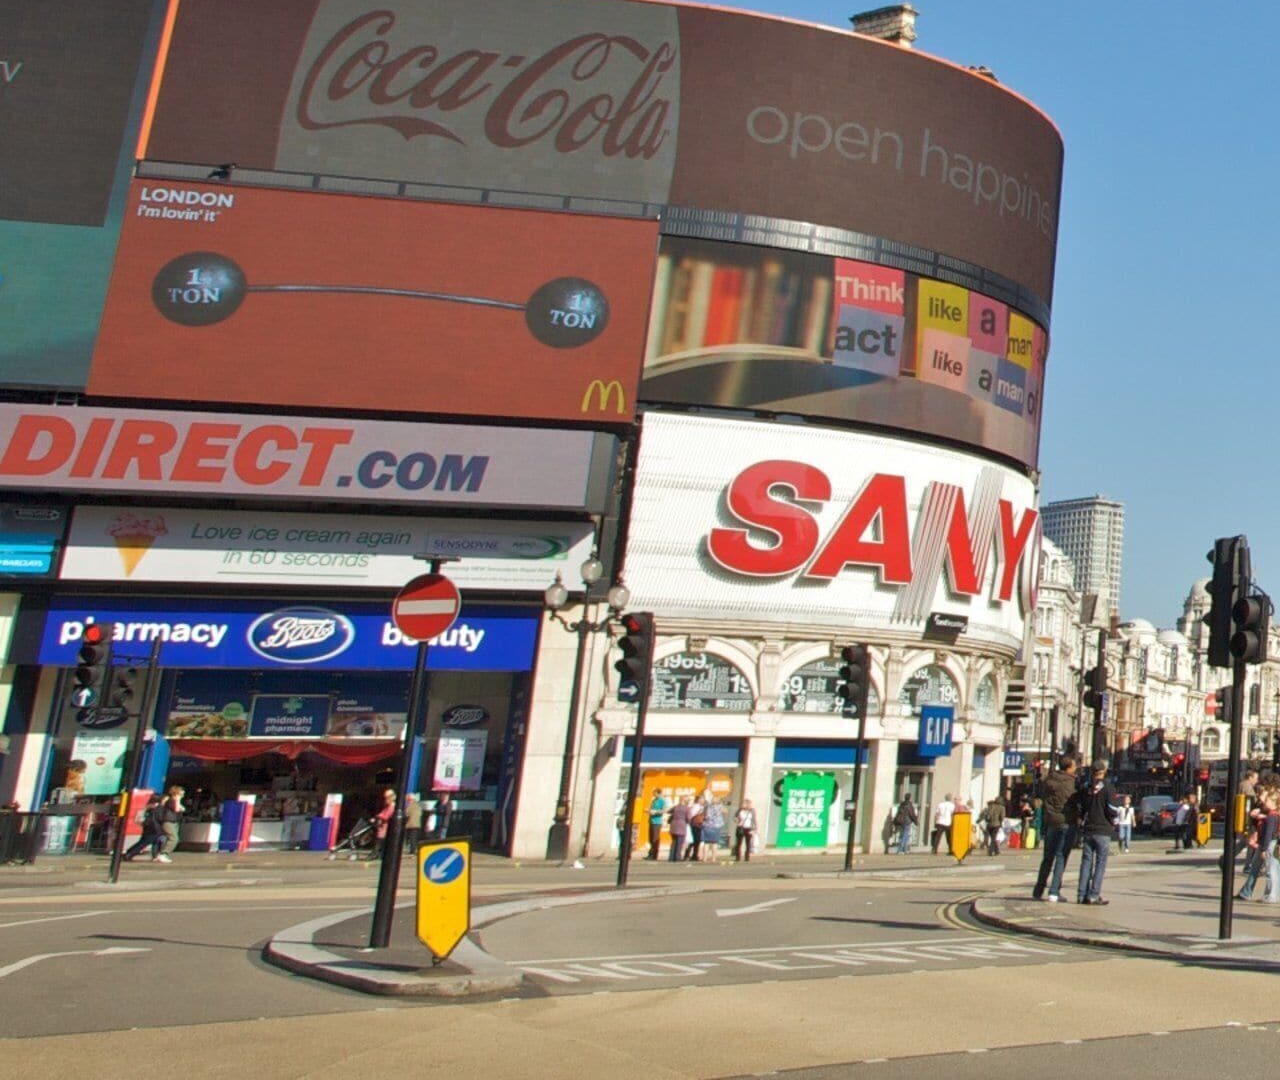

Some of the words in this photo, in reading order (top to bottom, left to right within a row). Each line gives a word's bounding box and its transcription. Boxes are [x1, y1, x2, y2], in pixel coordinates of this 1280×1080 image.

[297, 10, 676, 160] Coca-Cola
[746, 105, 904, 170] open
[920, 128, 1054, 235] happine
[141, 187, 234, 208] LONDON
[162, 207, 203, 220] lovin'
[204, 210, 216, 222] it
[186, 267, 202, 285] 1
[168, 287, 221, 304] TON
[569, 293, 584, 311] 1
[836, 276, 904, 303] Think
[550, 309, 597, 329] TON
[928, 296, 962, 322] like
[980, 308, 996, 336] a
[1009, 337, 1032, 356] man
[835, 324, 897, 357] act
[932, 349, 963, 376] like
[978, 368, 992, 392] a
[997, 378, 1024, 404] man
[0, 414, 490, 493] DIRECT.COM
[191, 523, 242, 540] Love
[249, 525, 279, 541] ice
[285, 528, 350, 544] cream
[356, 529, 411, 548] again
[707, 459, 1042, 612] SANY
[222, 548, 241, 565] in
[249, 549, 277, 565] 60
[59, 617, 228, 648] parmacy
[260, 616, 336, 648] Boots
[926, 717, 950, 746] GAP
[788, 797, 824, 809] SALE
[789, 789, 807, 797] THE
[808, 789, 825, 798] GAP
[785, 812, 823, 828] 60%
[518, 962, 720, 983] NO
